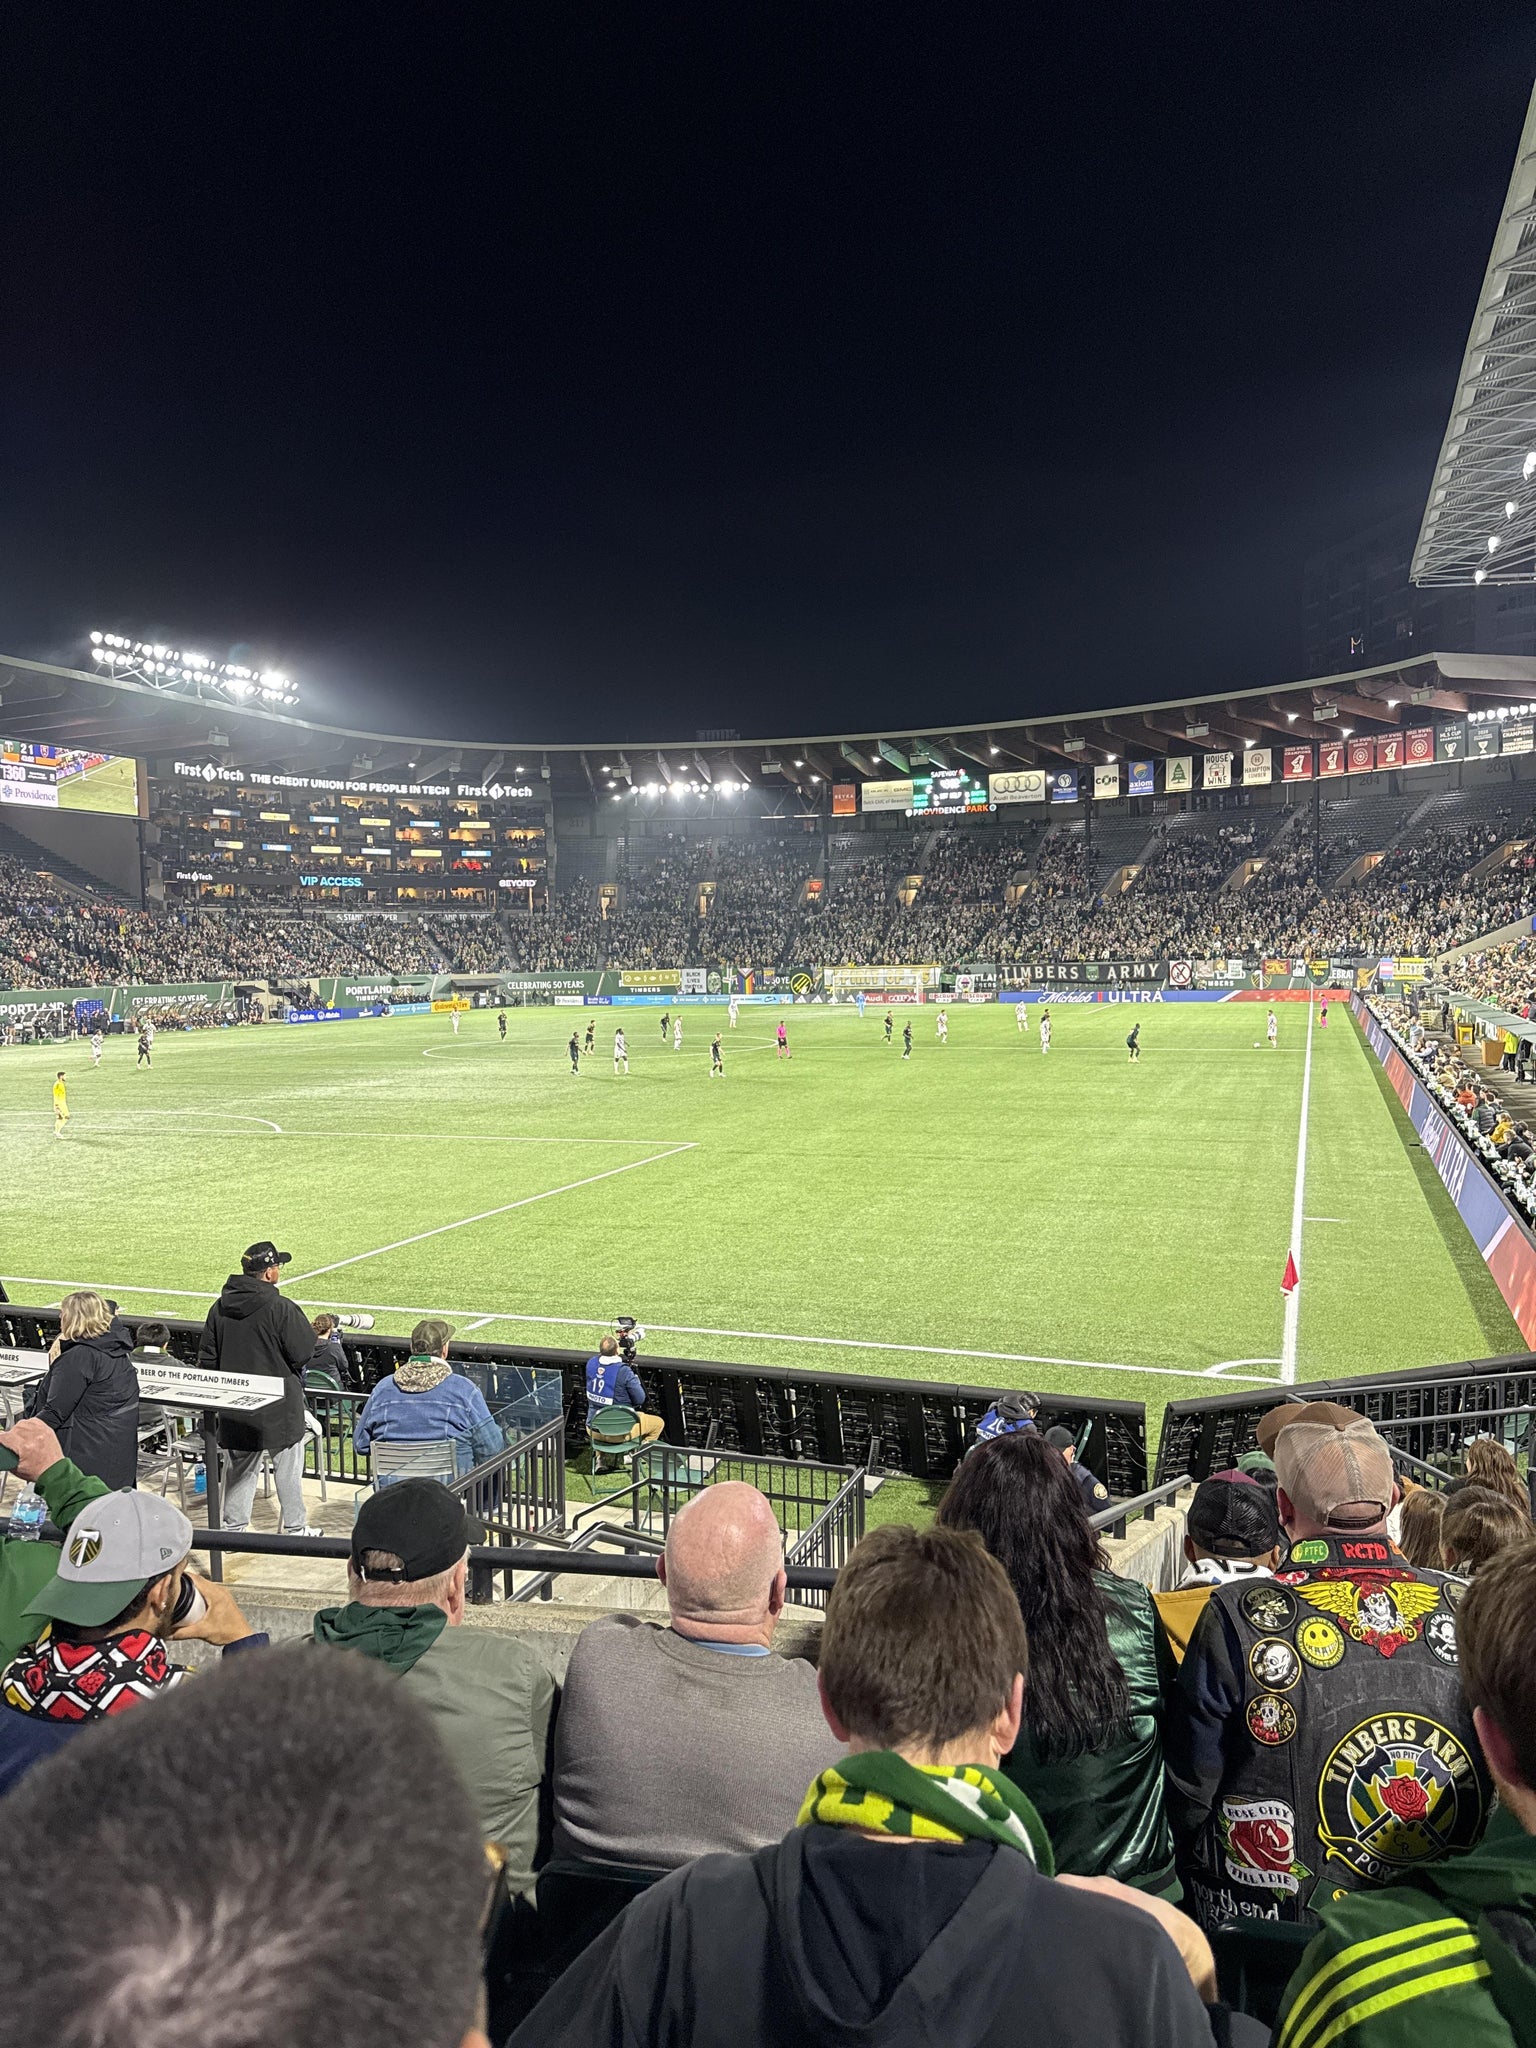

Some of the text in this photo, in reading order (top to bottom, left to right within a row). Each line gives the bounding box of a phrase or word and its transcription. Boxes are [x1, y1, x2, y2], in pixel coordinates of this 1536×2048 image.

[20, 744, 34, 756] 2 1
[1206, 754, 1228, 763] HOUSE
[174, 762, 244, 782] First Tech
[930, 770, 958, 778] SAFEWAY
[1245, 766, 1270, 774] HAMPTON
[1486, 762, 1508, 774] 203
[250, 774, 450, 795] THE CREDIT UNION FOR PEOPLE IN TECH
[1208, 776, 1226, 784] WINE
[1359, 775, 1379, 786] 204
[15, 788, 56, 802] Providence
[458, 784, 532, 797] First Tech
[1105, 800, 1124, 808] 206
[176, 872, 212, 881] First Tech
[300, 876, 318, 886] VIP
[1001, 966, 1079, 980] TIMBERS
[1107, 964, 1160, 980] ARMY
[346, 985, 393, 996] PORTLAND
[507, 980, 584, 989] CELEBRATING 50 YEARS
[1038, 991, 1163, 1003] Michelob ULTRA
[169, 1371, 180, 1379] THE
[183, 1373, 218, 1383] PORTLAND
[221, 1378, 249, 1386] TIMBERS
[592, 1378, 604, 1394] 19
[1304, 1546, 1324, 1556] PTFC
[1342, 1543, 1388, 1560] RCTD
[1326, 1719, 1475, 1790] TIMBERS ARMY
[1403, 1752, 1420, 1760] PITY
[1228, 1806, 1290, 1818] ROSE CITY
[1230, 1865, 1257, 1884] TILL
[1268, 1872, 1291, 1886] DIE
